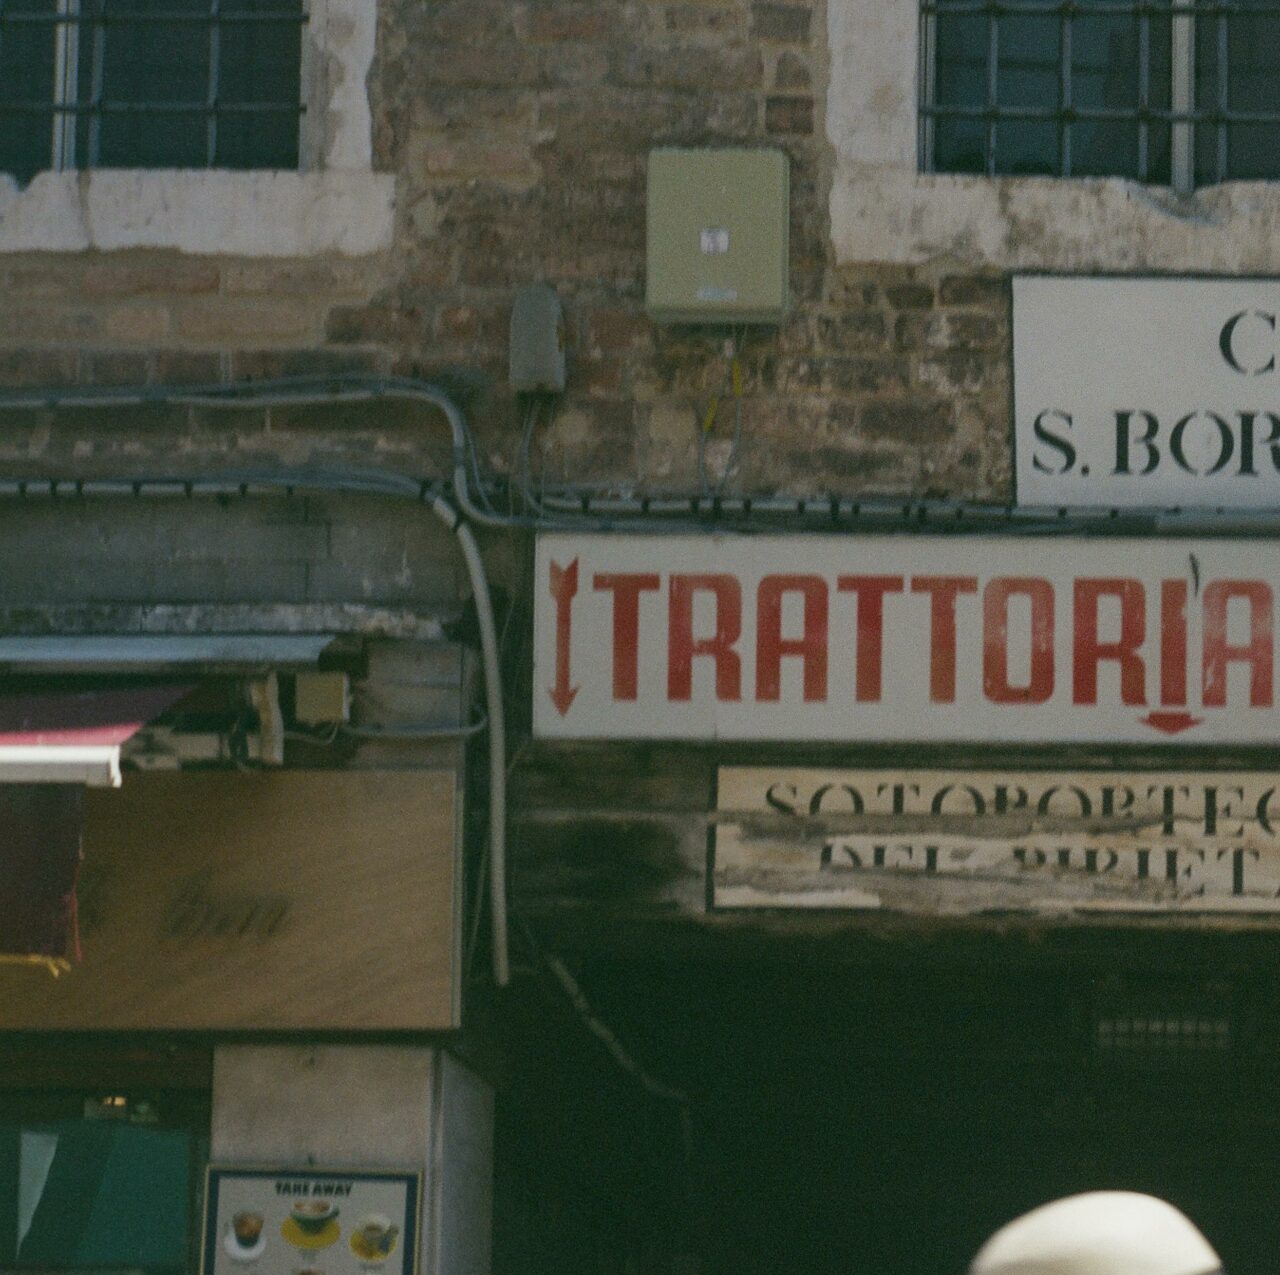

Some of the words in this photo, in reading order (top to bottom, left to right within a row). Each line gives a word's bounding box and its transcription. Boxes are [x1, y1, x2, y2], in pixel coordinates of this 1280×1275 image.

[592, 572, 1275, 708] TRATTORIA
[275, 1180, 310, 1196] TAKE
[312, 1181, 353, 1197] AWAY
